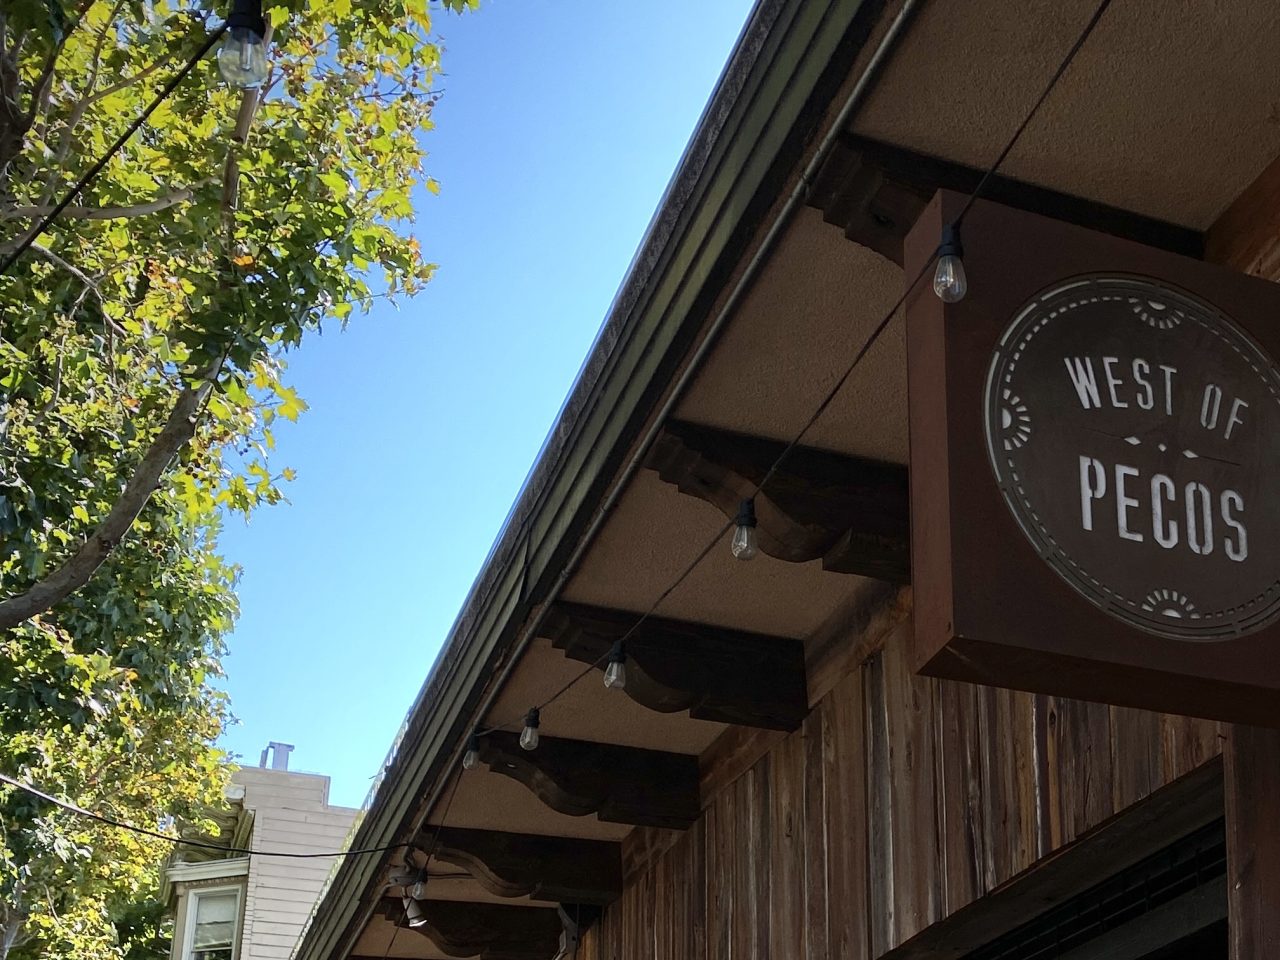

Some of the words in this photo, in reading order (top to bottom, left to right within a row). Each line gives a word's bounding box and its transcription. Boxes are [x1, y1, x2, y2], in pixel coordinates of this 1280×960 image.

[1063, 356, 1178, 416] WEST
[1200, 383, 1249, 440] OF
[1078, 455, 1250, 563] PECOS
